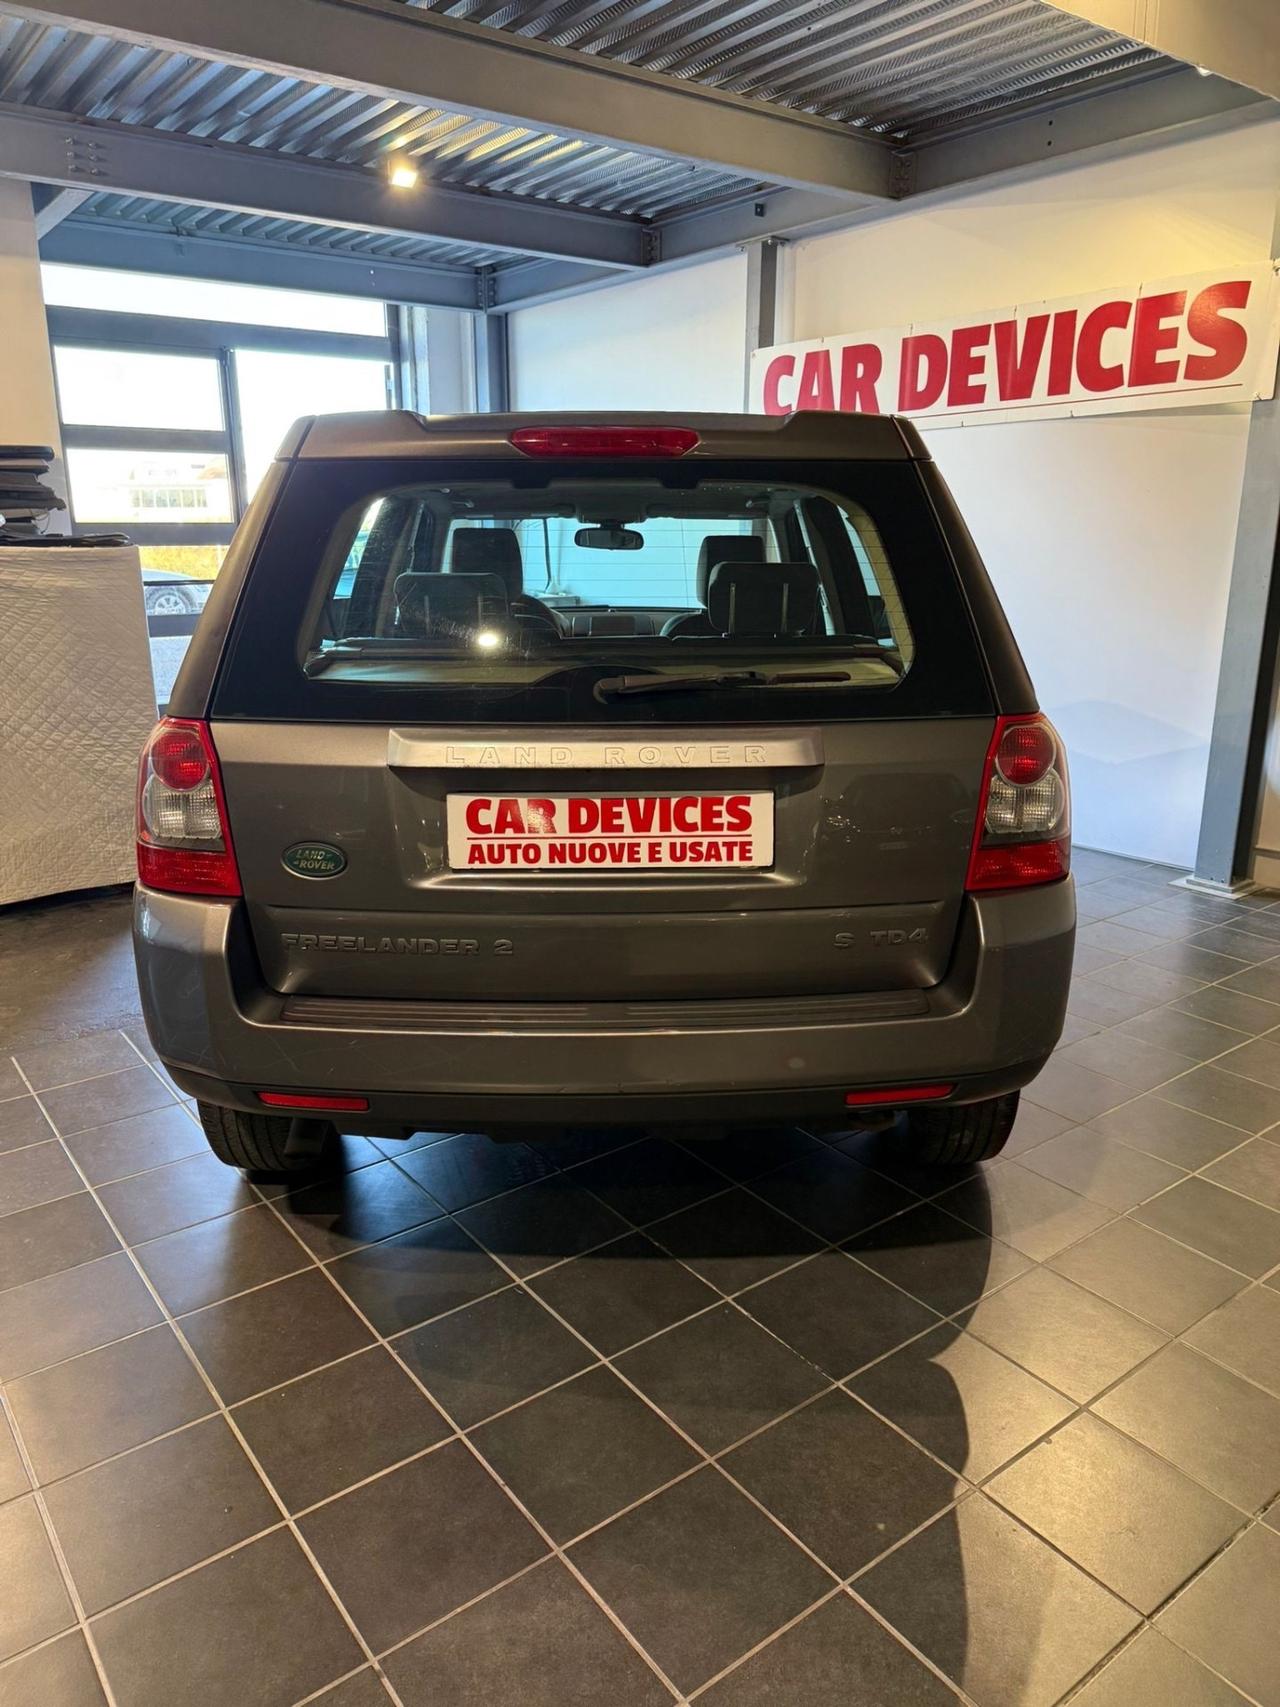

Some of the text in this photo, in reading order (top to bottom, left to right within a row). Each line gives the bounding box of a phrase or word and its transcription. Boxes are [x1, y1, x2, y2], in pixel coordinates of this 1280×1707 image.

[763, 281, 1252, 415] CAR DEVICES
[446, 745, 768, 765] LAND ROVER
[465, 796, 753, 835] CAR DEVICES
[467, 840, 753, 865] AUTO NUOVE E USATE
[280, 933, 514, 955] FREELANDER 2
[834, 928, 928, 948] S TD4
